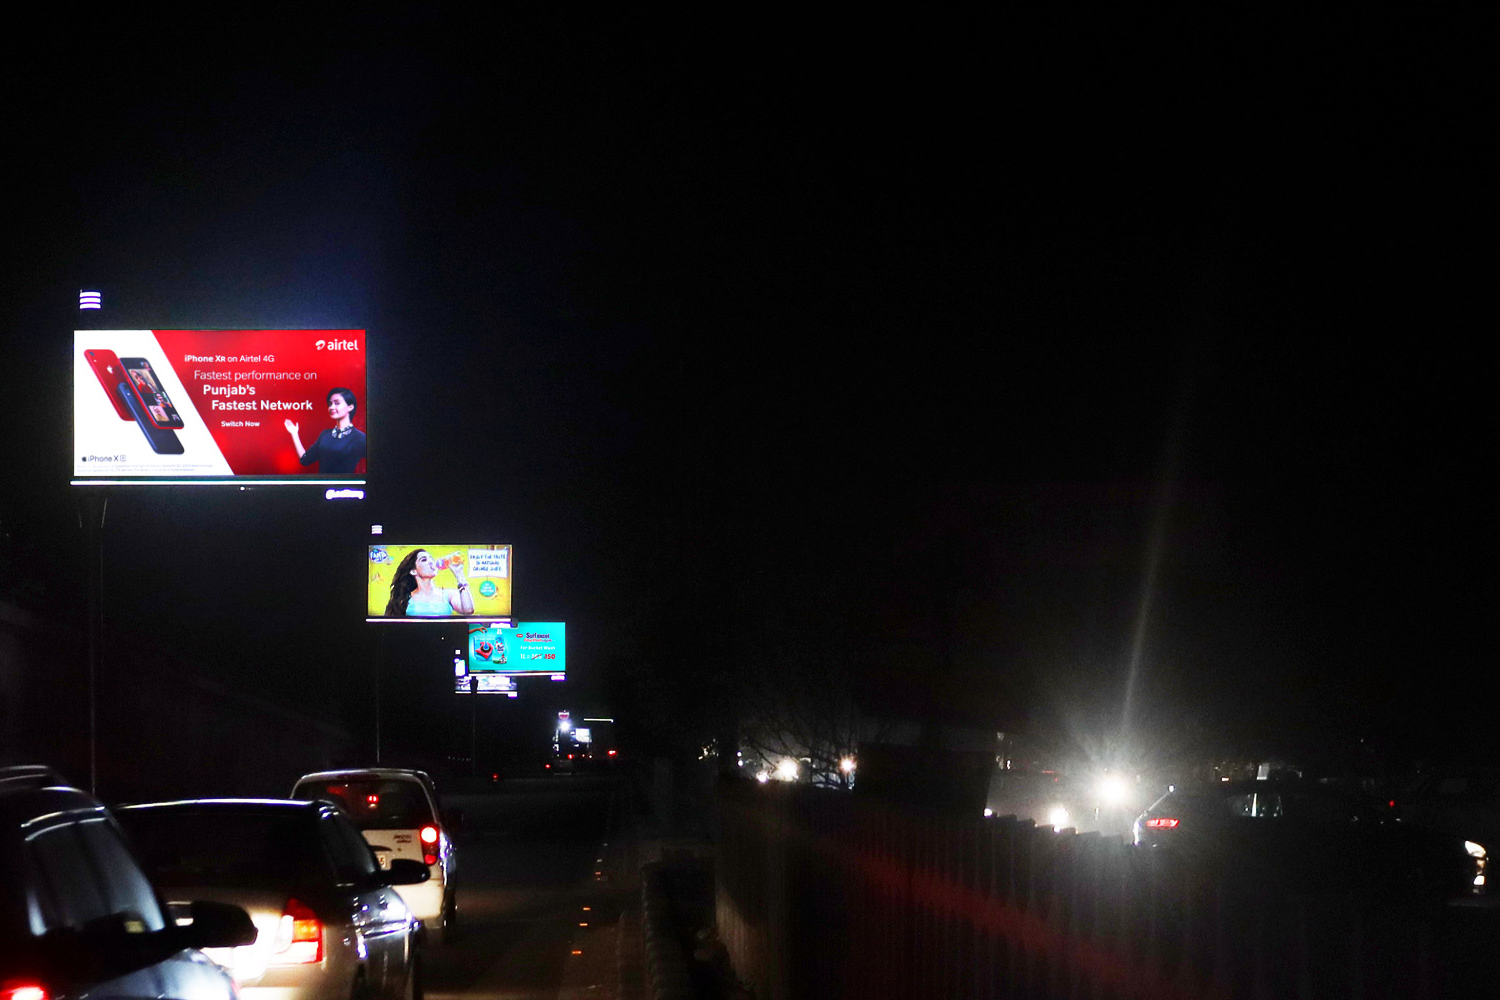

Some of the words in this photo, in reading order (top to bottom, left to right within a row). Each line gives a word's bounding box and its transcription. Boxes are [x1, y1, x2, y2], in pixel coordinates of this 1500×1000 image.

[327, 339, 359, 351] airtel
[184, 355, 214, 363] iPhone
[239, 355, 261, 363] Airtel
[262, 355, 275, 363] 4G
[194, 370, 232, 380] Fastest
[234, 370, 302, 383] performance
[303, 372, 318, 380] on
[211, 400, 257, 411] Fastest
[260, 400, 314, 411] Network
[221, 420, 244, 428] Switch
[245, 420, 260, 428] Now
[87, 455, 113, 463] iPhone
